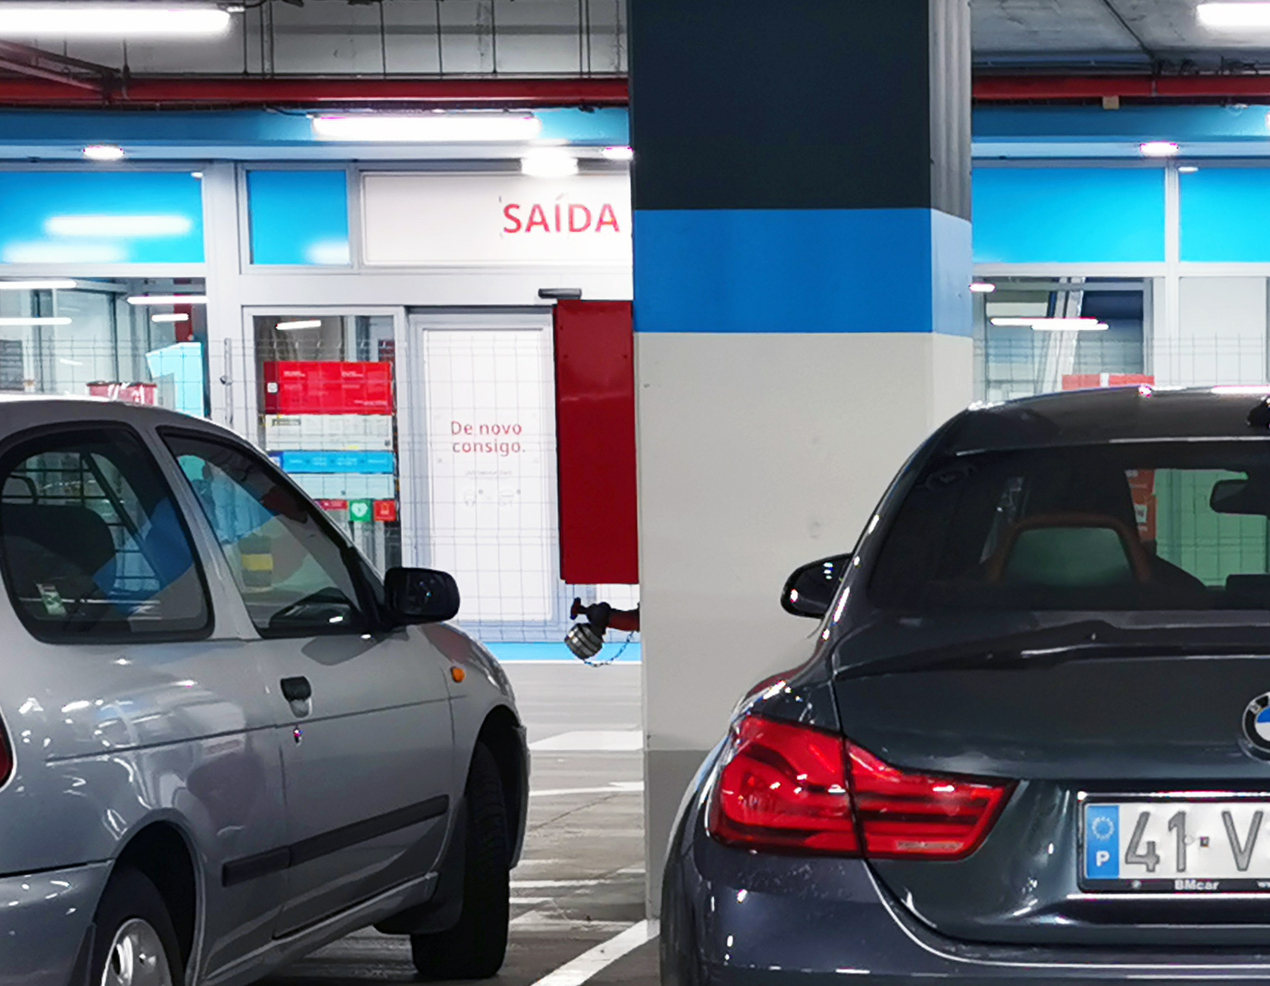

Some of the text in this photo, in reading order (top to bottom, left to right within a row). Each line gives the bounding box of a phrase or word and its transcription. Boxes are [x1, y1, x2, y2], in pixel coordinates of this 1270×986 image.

[503, 192, 620, 233] SAÍDA
[451, 420, 522, 436] De novo
[452, 439, 526, 457] consigo.
[1096, 850, 1110, 867] P
[1174, 879, 1220, 891] BMcar
